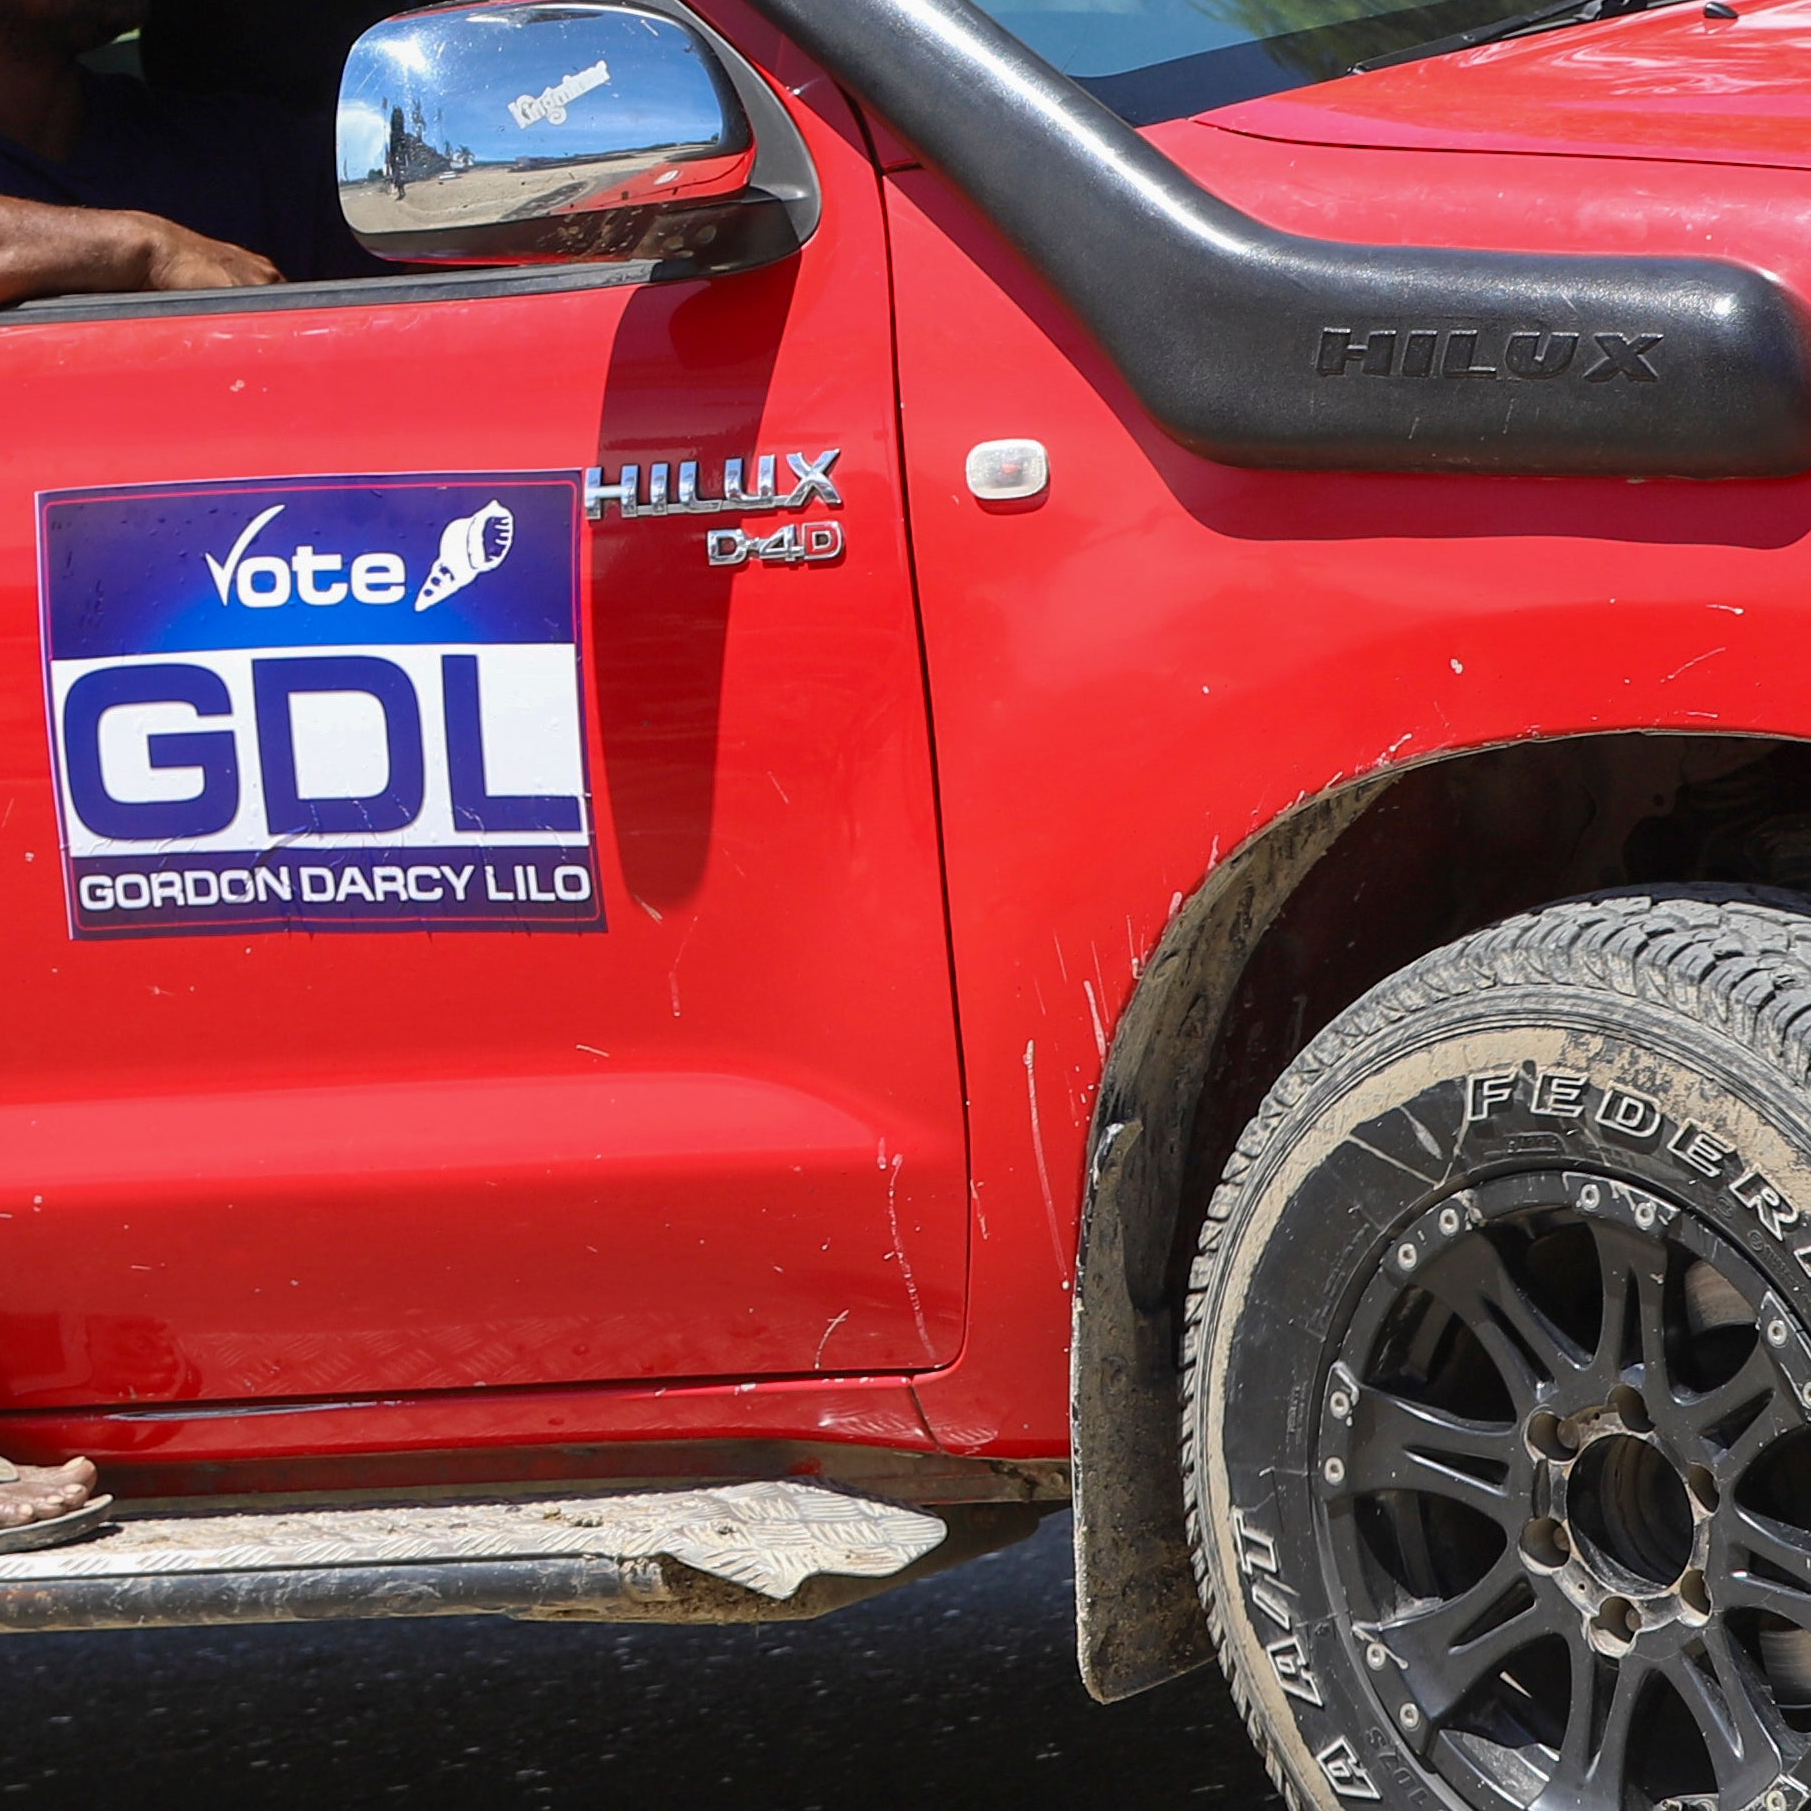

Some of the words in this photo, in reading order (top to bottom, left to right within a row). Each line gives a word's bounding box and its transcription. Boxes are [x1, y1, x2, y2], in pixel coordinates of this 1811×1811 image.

[1313, 326, 1666, 384] HILUX
[584, 448, 842, 520] HILUX
[62, 653, 582, 841] GDL
[80, 866, 292, 911] GORDON
[300, 865, 475, 904] DARCY
[484, 864, 592, 904] LILO
[1467, 1068, 1811, 1280] FEDER
